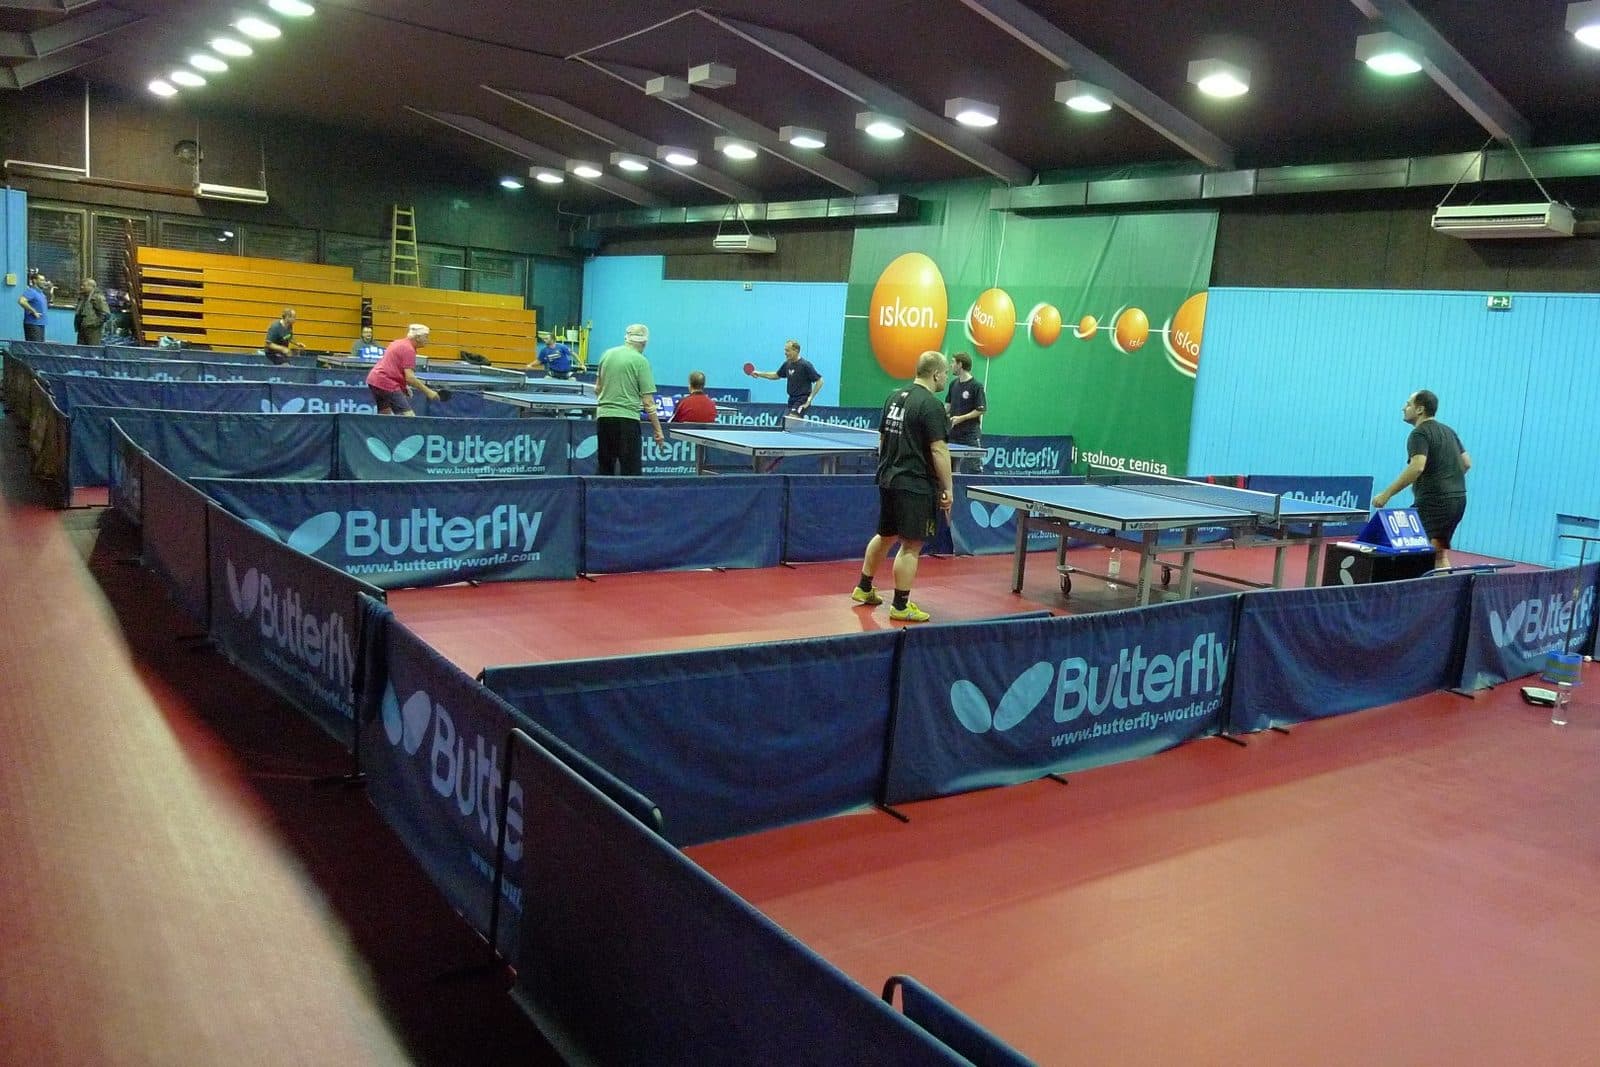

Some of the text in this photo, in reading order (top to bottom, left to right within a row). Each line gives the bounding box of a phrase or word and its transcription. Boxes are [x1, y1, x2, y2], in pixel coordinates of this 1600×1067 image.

[427, 433, 547, 466] Butterfly
[994, 446, 1060, 470] Butterfly
[1082, 449, 1125, 471] stolnog
[1129, 457, 1168, 475] tenisa
[427, 464, 546, 476] www.butterfly-world.com
[345, 504, 544, 557] Butterfly
[345, 551, 542, 576] www.butterfly-world.com
[1523, 585, 1594, 643] Butterfl
[1053, 631, 1229, 724] Butterfly
[1050, 698, 1223, 748] www.butterfly-world.co
